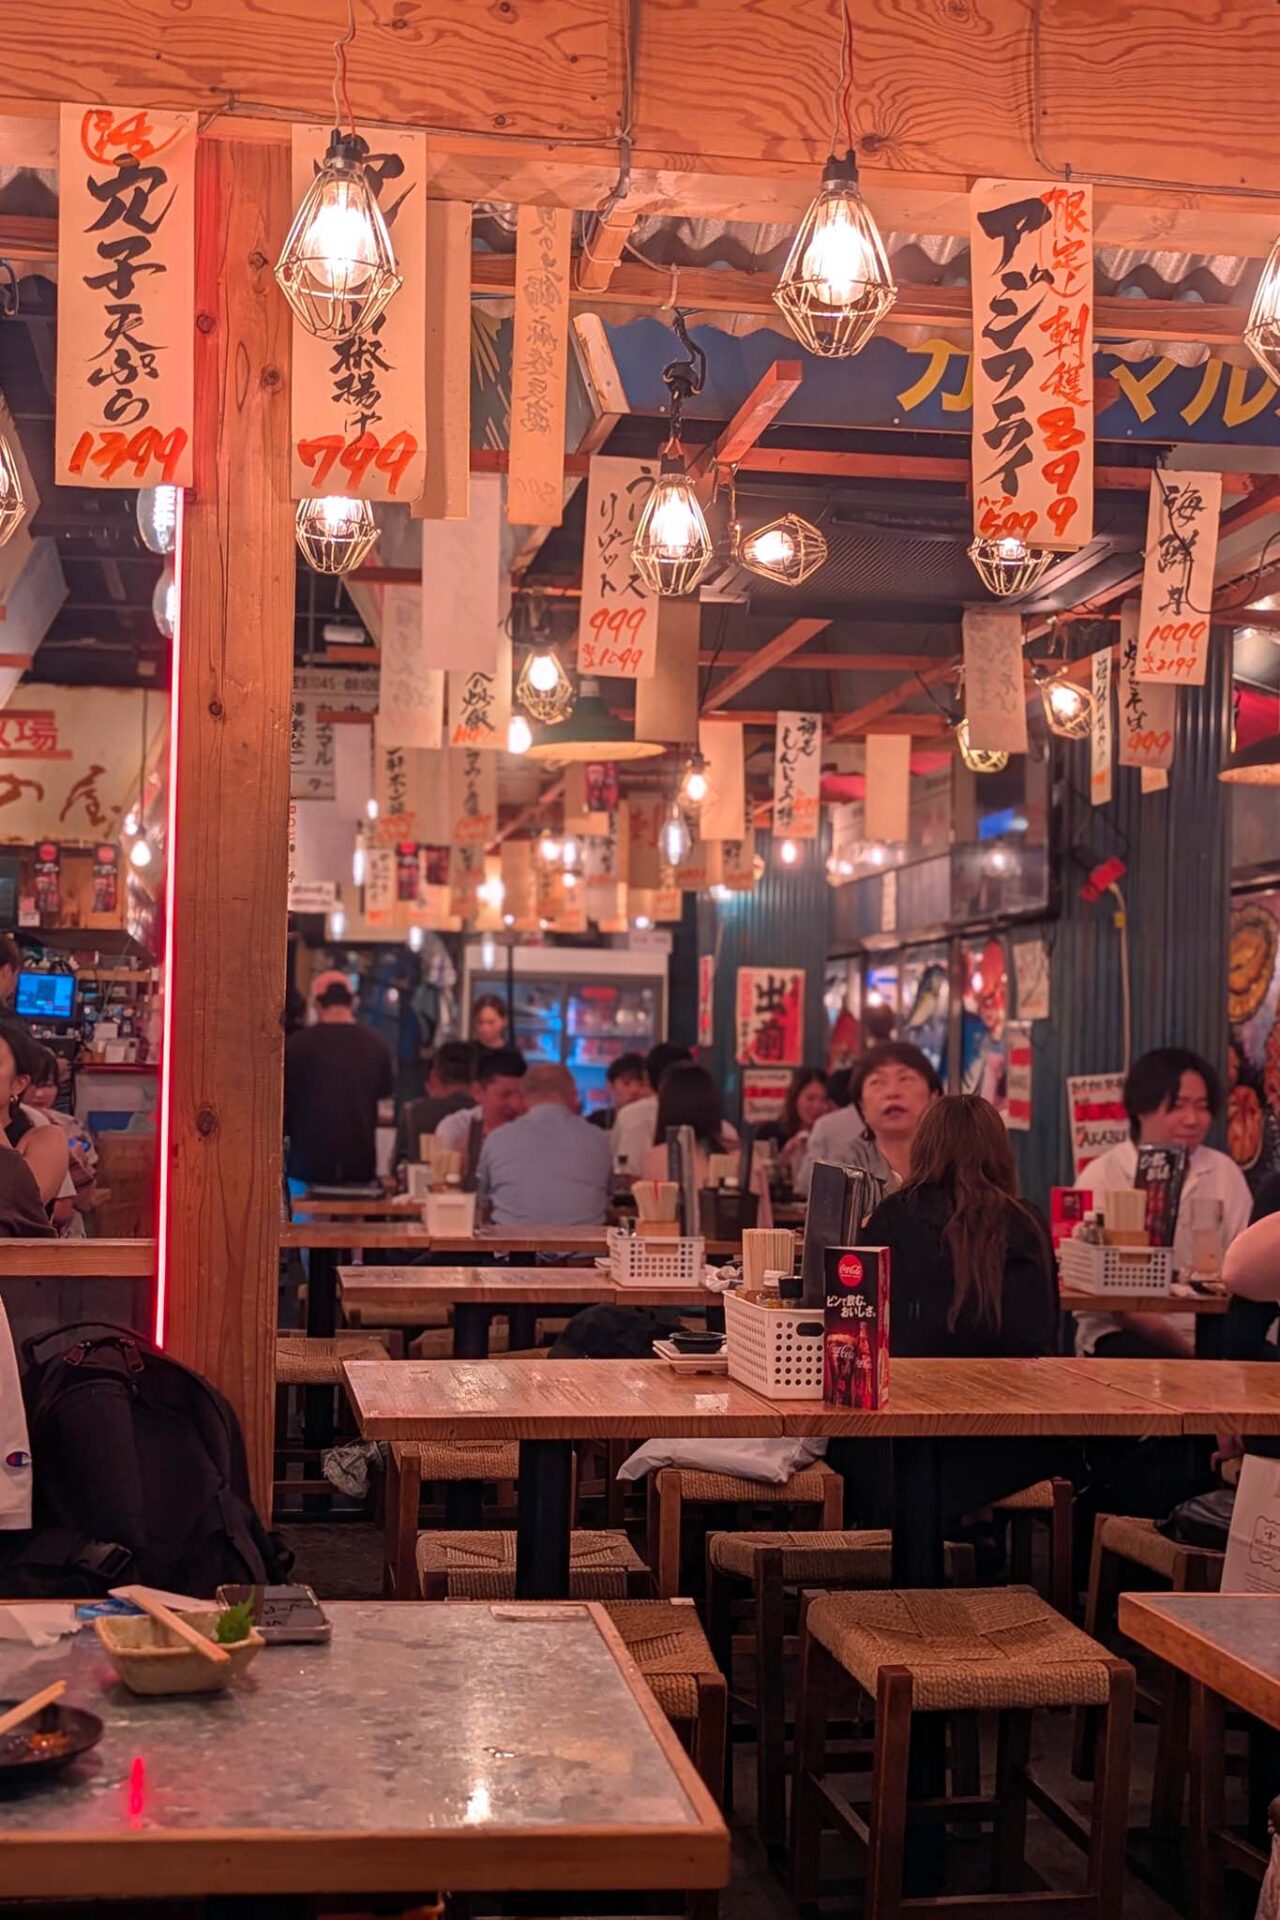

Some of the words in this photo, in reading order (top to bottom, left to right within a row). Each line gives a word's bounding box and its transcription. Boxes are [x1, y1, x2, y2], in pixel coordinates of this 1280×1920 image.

[82, 152, 178, 428] 穴子天ぷら
[977, 197, 1054, 497] アジフライ
[298, 430, 418, 496] 799
[1037, 406, 1086, 537] 899
[599, 492, 623, 599] リゾット
[979, 506, 1038, 541] 599
[1157, 482, 1207, 618] 海鮮丼
[588, 602, 646, 646] 999
[1145, 620, 1207, 654] 1999
[1157, 656, 1198, 676] 2199
[755, 974, 787, 1062] 出前
